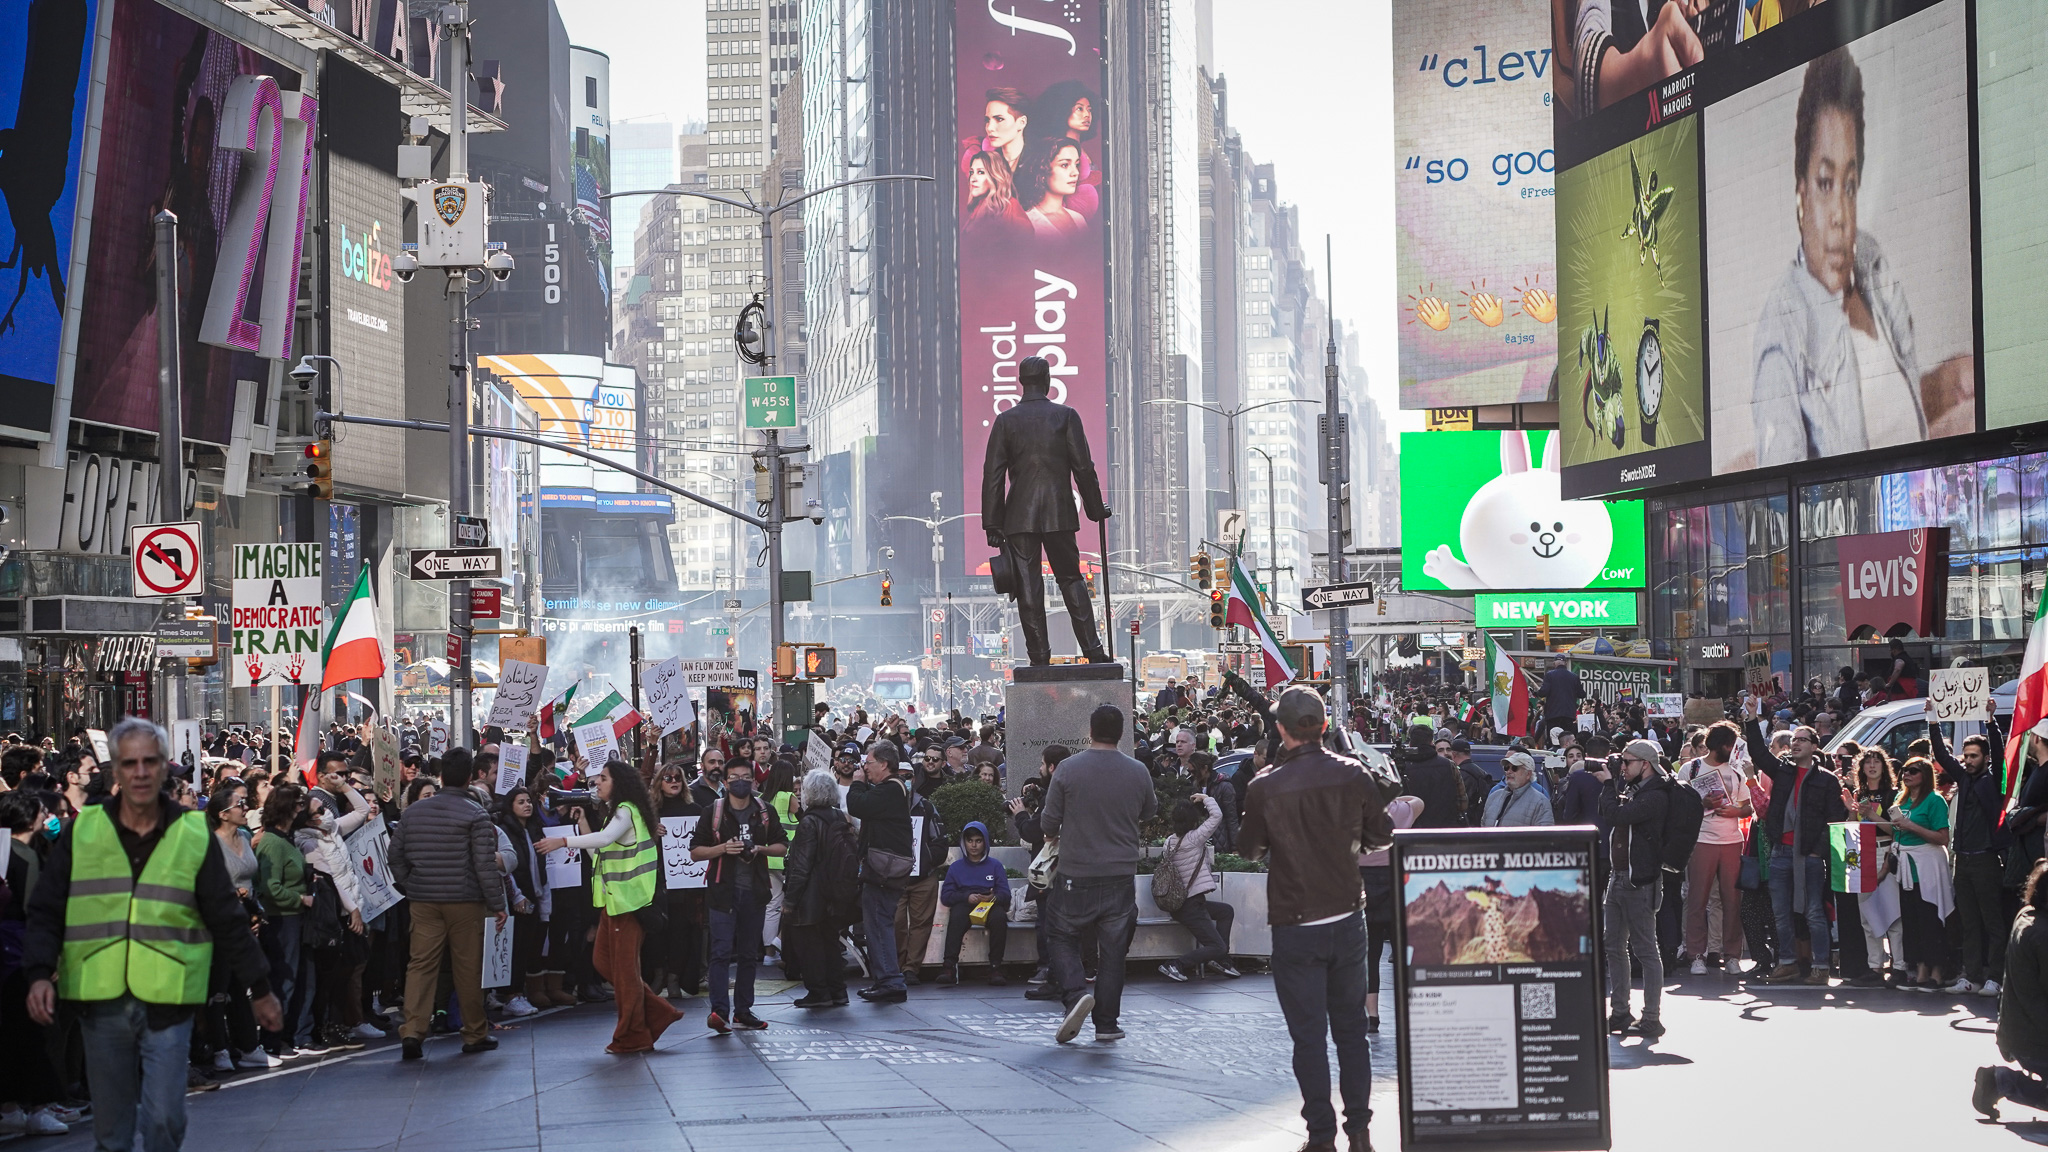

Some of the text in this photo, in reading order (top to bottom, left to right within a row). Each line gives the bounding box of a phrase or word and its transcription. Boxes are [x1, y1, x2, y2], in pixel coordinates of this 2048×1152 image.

[1419, 45, 1552, 88] “clev
[1662, 72, 1696, 100] MARRIOTT
[1663, 94, 1692, 117] MARQUIS
[1520, 186, 1555, 200] @Free
[341, 224, 391, 291] belize
[544, 223, 561, 304] 1500
[1023, 269, 1079, 405] oplay
[763, 382, 777, 393] TO
[600, 392, 624, 406] YOU
[752, 396, 790, 407] W 45 St
[608, 410, 625, 426] TO
[1620, 464, 1656, 482] #SwatchXDBZ
[460, 526, 484, 538] ONE WAY
[234, 544, 321, 579] IMAGINE
[424, 557, 490, 571] ONE WAY
[268, 580, 288, 606] A
[1313, 589, 1364, 603] ONE WAY
[615, 602, 641, 611] new
[1493, 600, 1609, 619] NEW YORK
[234, 606, 321, 629] DEMOCRATIC
[648, 619, 664, 631] film
[180, 629, 204, 637] Square
[233, 628, 318, 655] IRAN
[96, 637, 156, 671] FOREVER
[1702, 643, 1725, 658] swatch
[696, 662, 714, 670] FLOW
[716, 661, 733, 670] ZONE
[689, 673, 734, 682] KEEP MOVING
[1580, 669, 1650, 682] DISCOVER
[492, 706, 512, 716] REZA
[582, 724, 606, 740] FREE
[505, 747, 522, 760] FREE
[1403, 852, 1588, 872] MIDNIGHT MOMENT
[759, 1045, 918, 1055] LYCEUM
[764, 1051, 952, 1062] PALACE
